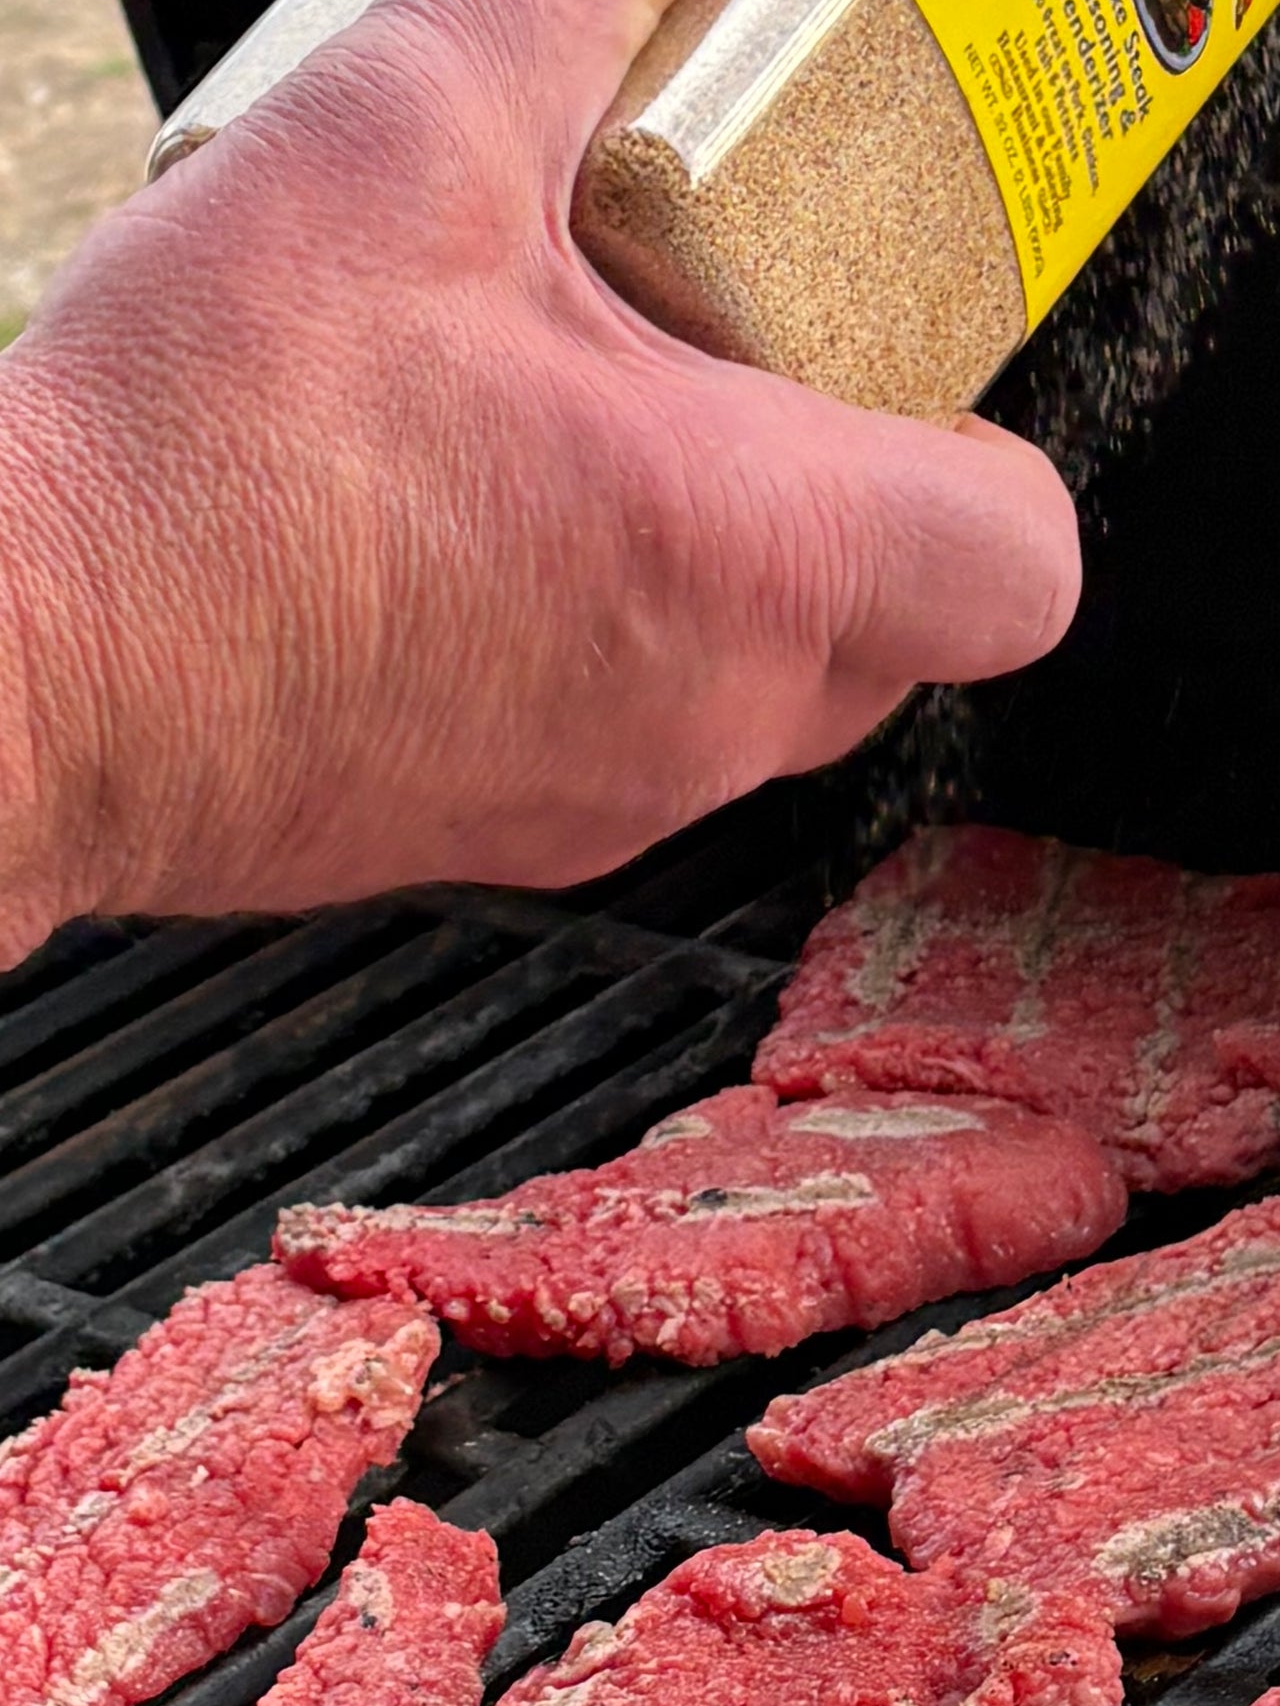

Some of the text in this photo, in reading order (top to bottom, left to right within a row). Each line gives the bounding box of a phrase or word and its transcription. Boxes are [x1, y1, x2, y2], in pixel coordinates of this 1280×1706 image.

[963, 42, 987, 79] NET
[1035, 34, 1054, 75] Fish
[1123, 30, 1154, 125] Steak
[1119, 108, 1138, 137] &
